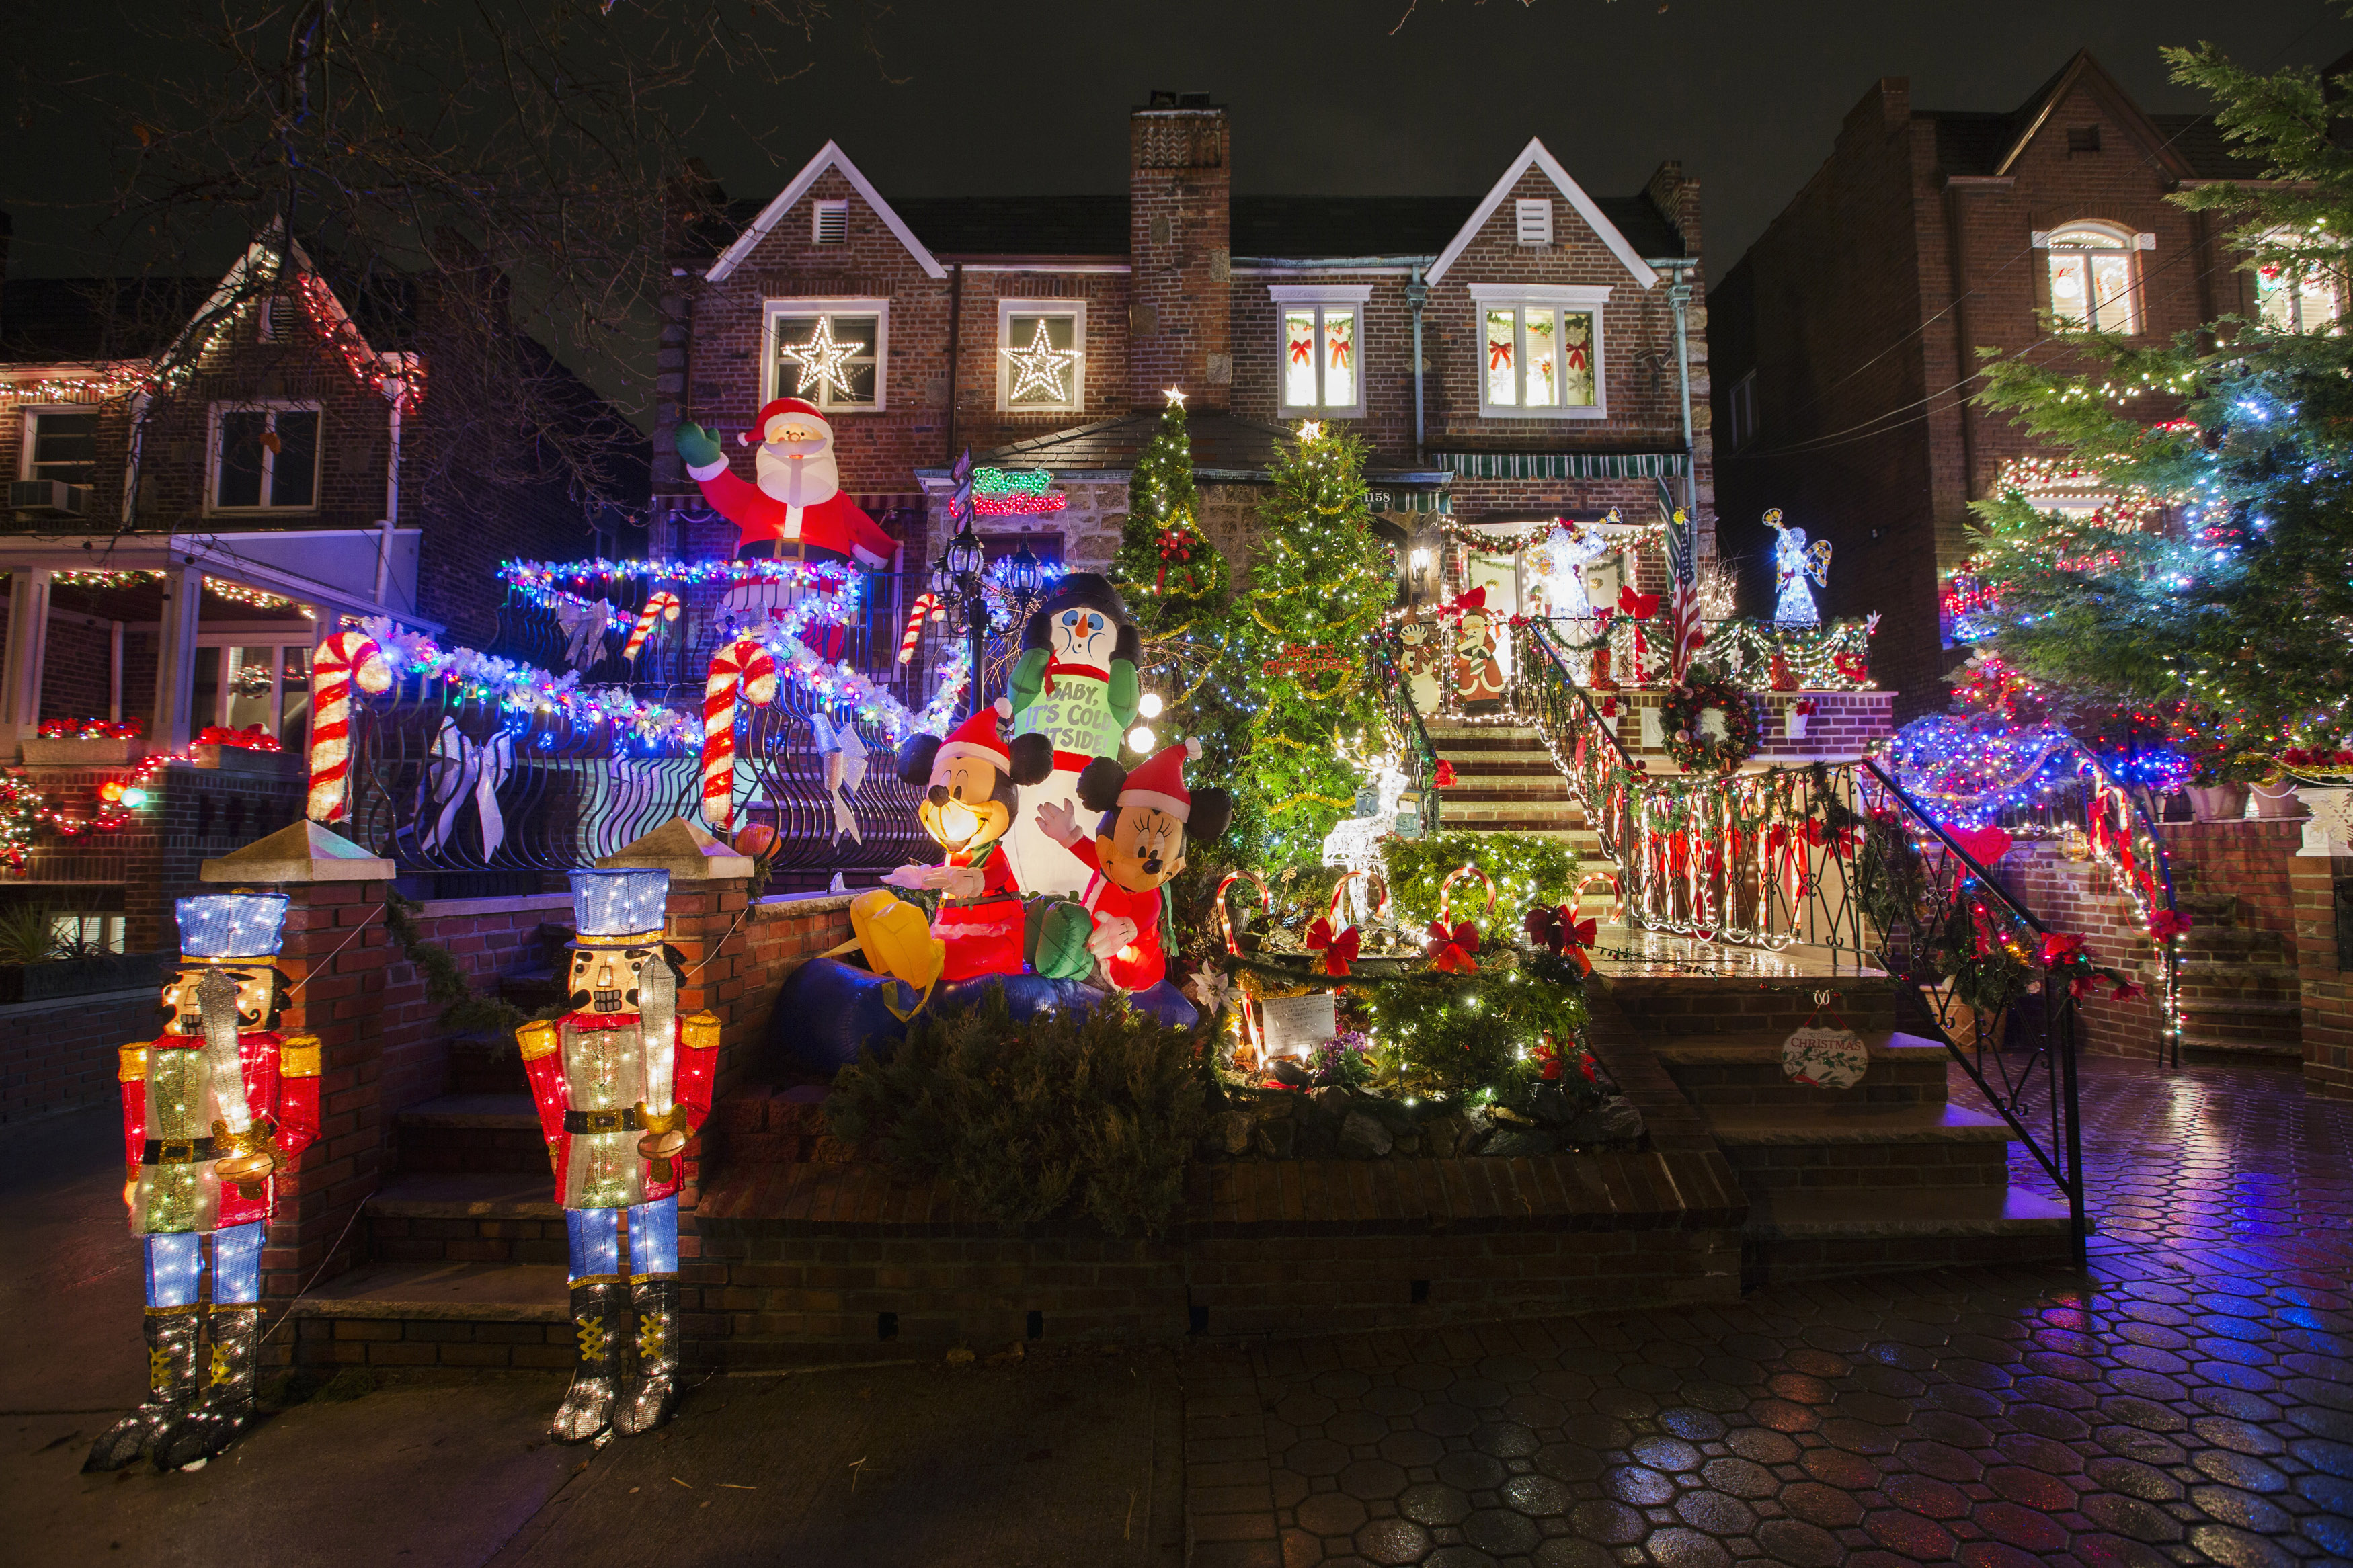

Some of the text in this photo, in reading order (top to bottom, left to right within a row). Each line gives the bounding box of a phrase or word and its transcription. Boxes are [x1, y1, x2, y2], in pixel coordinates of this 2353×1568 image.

[1364, 491, 1390, 503] 1158
[1279, 641, 1334, 660] Merry
[1025, 704, 1113, 732] IT'S COLD
[1790, 1037, 1861, 1050] CHRISTMAS
